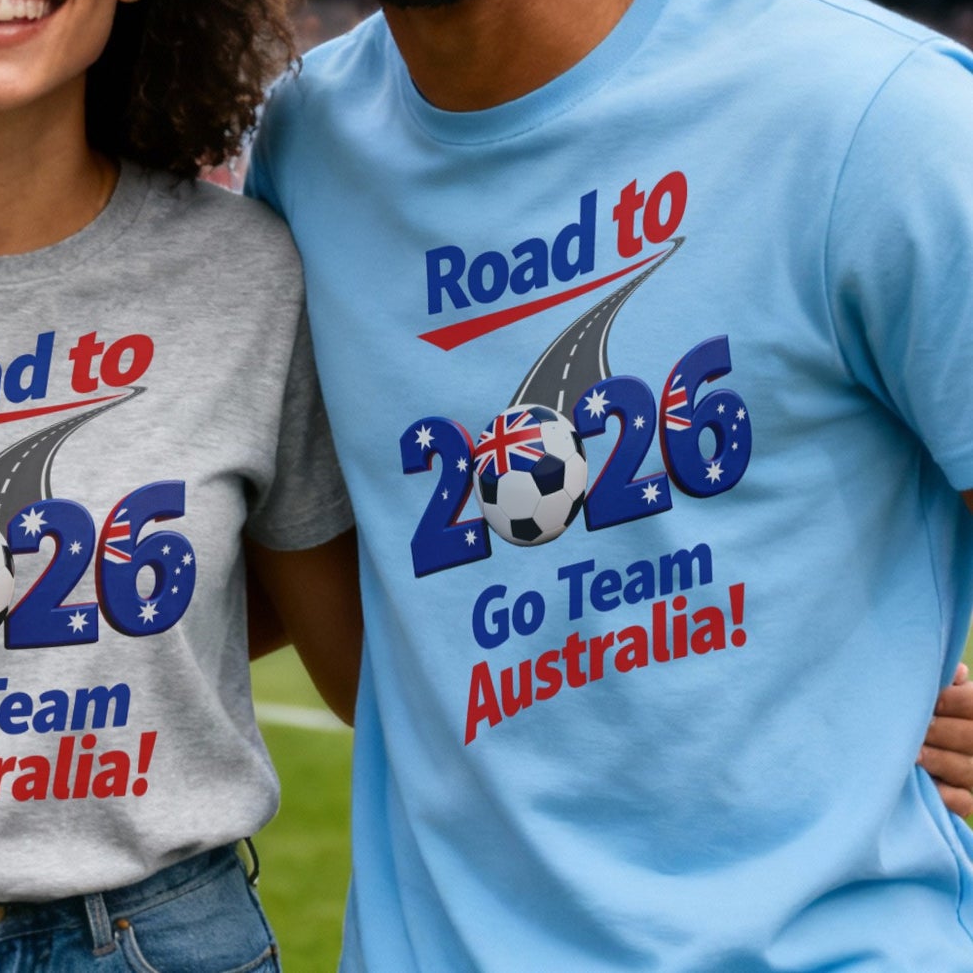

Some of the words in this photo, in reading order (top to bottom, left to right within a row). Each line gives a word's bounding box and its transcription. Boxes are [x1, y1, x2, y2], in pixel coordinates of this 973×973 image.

[425, 188, 598, 315] Road
[612, 170, 688, 258] to
[68, 331, 155, 393] to
[471, 584, 546, 650] Go
[557, 542, 713, 622] Team
[464, 582, 746, 746] Australia!
